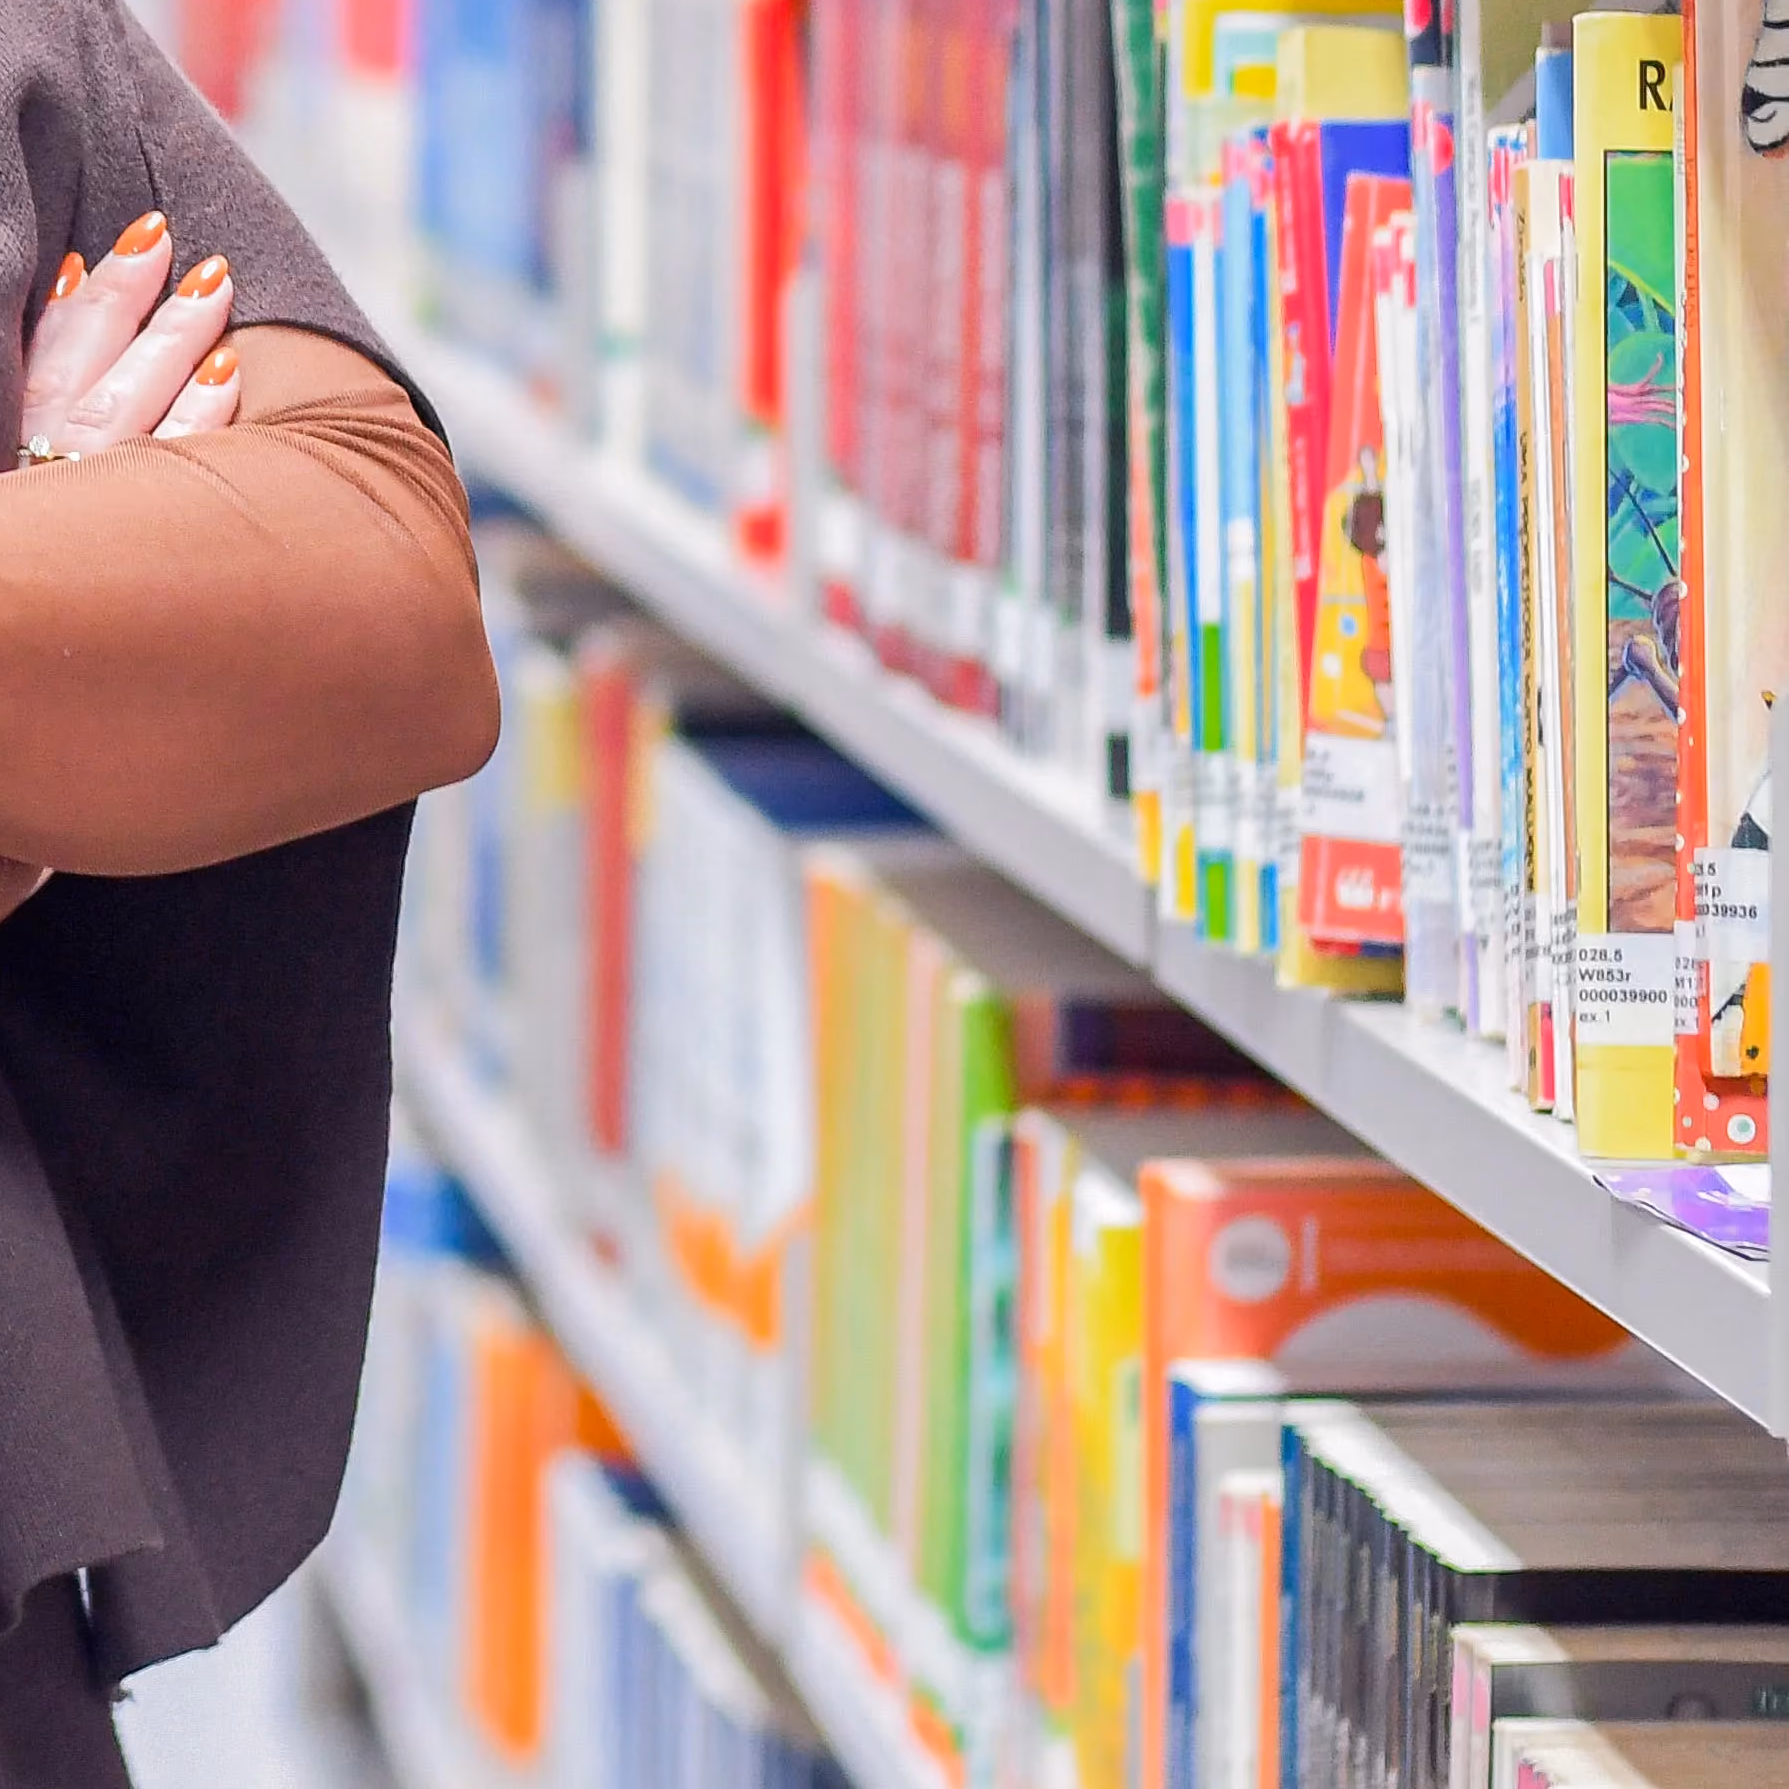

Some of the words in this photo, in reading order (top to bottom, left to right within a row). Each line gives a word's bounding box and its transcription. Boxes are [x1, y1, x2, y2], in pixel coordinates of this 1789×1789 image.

[1639, 59, 1673, 111] R
[1579, 947, 1623, 962] 028.5
[1579, 987, 1668, 1004] 000039900
